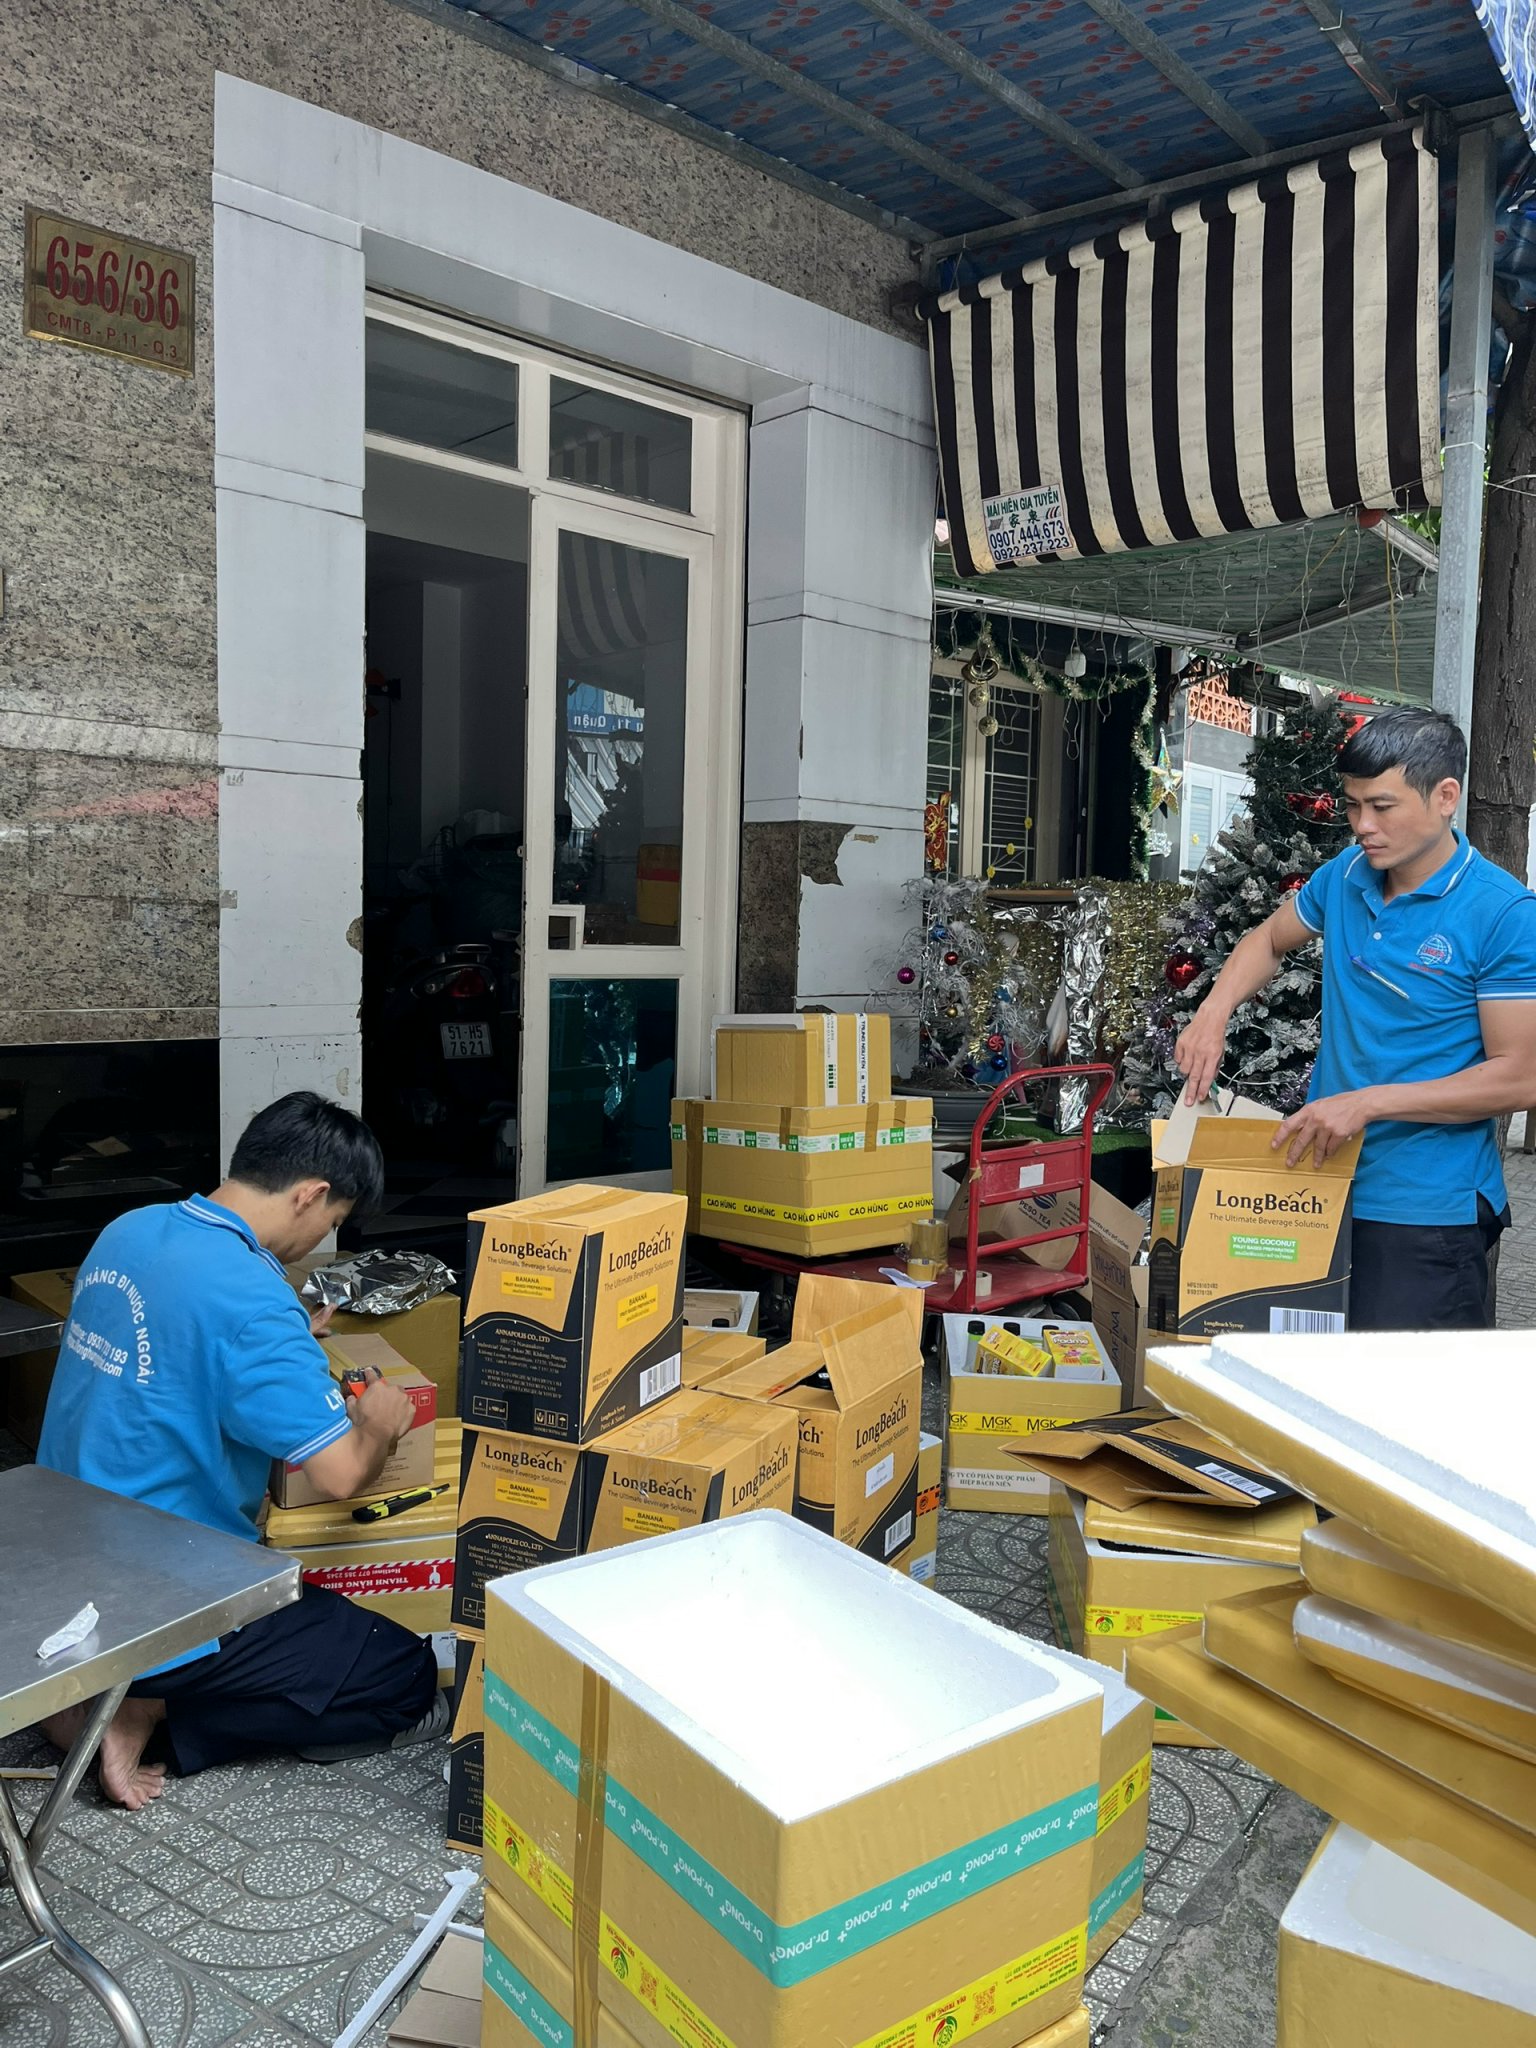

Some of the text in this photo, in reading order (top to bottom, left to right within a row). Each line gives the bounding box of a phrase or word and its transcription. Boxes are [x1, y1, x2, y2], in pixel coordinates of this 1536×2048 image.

[46, 235, 180, 331] 656/36
[153, 340, 178, 360] Q.3
[986, 501, 1000, 518] MÁI
[1020, 496, 1033, 511] GIA
[989, 520, 1065, 549] 0907.444.673
[994, 537, 1070, 561] 0922.237.223
[849, 1207, 866, 1216] CAO
[867, 1203, 889, 1214] HÙNG
[898, 1200, 914, 1209] CAO
[1215, 1189, 1323, 1215] LongBeach
[743, 1204, 757, 1213] CAO
[783, 1211, 797, 1221] CAO
[1019, 1200, 1037, 1215] PESO
[1039, 1213, 1051, 1227] TEA
[1209, 1213, 1329, 1230] The Ultimate Beverage Solutions
[491, 1237, 567, 1262] LongBeach
[1232, 1235, 1296, 1247] YOUNG COCONUT
[608, 1231, 671, 1273] LongBeach
[521, 1261, 546, 1271] Beverage
[547, 1265, 572, 1274] Solutions
[117, 1274, 131, 1291] ĐI
[515, 1276, 540, 1284] BANANA
[604, 1282, 613, 1292] The
[628, 1292, 648, 1306] BANANA
[109, 1347, 128, 1364] 193
[856, 1398, 907, 1450] LongBeach
[948, 1413, 968, 1426] GK
[981, 1415, 1013, 1429] MGK
[1026, 1418, 1057, 1431] MGK
[485, 1444, 562, 1473] LongBeach
[541, 1474, 567, 1486] Solutions
[612, 1471, 692, 1501] LongBeach
[732, 1447, 788, 1508] LongBeach
[509, 1483, 535, 1493] BANANA
[607, 1489, 619, 1497] The
[670, 1503, 697, 1515] Solutions
[637, 1512, 663, 1523] BANANA
[375, 1577, 408, 1586] THANH
